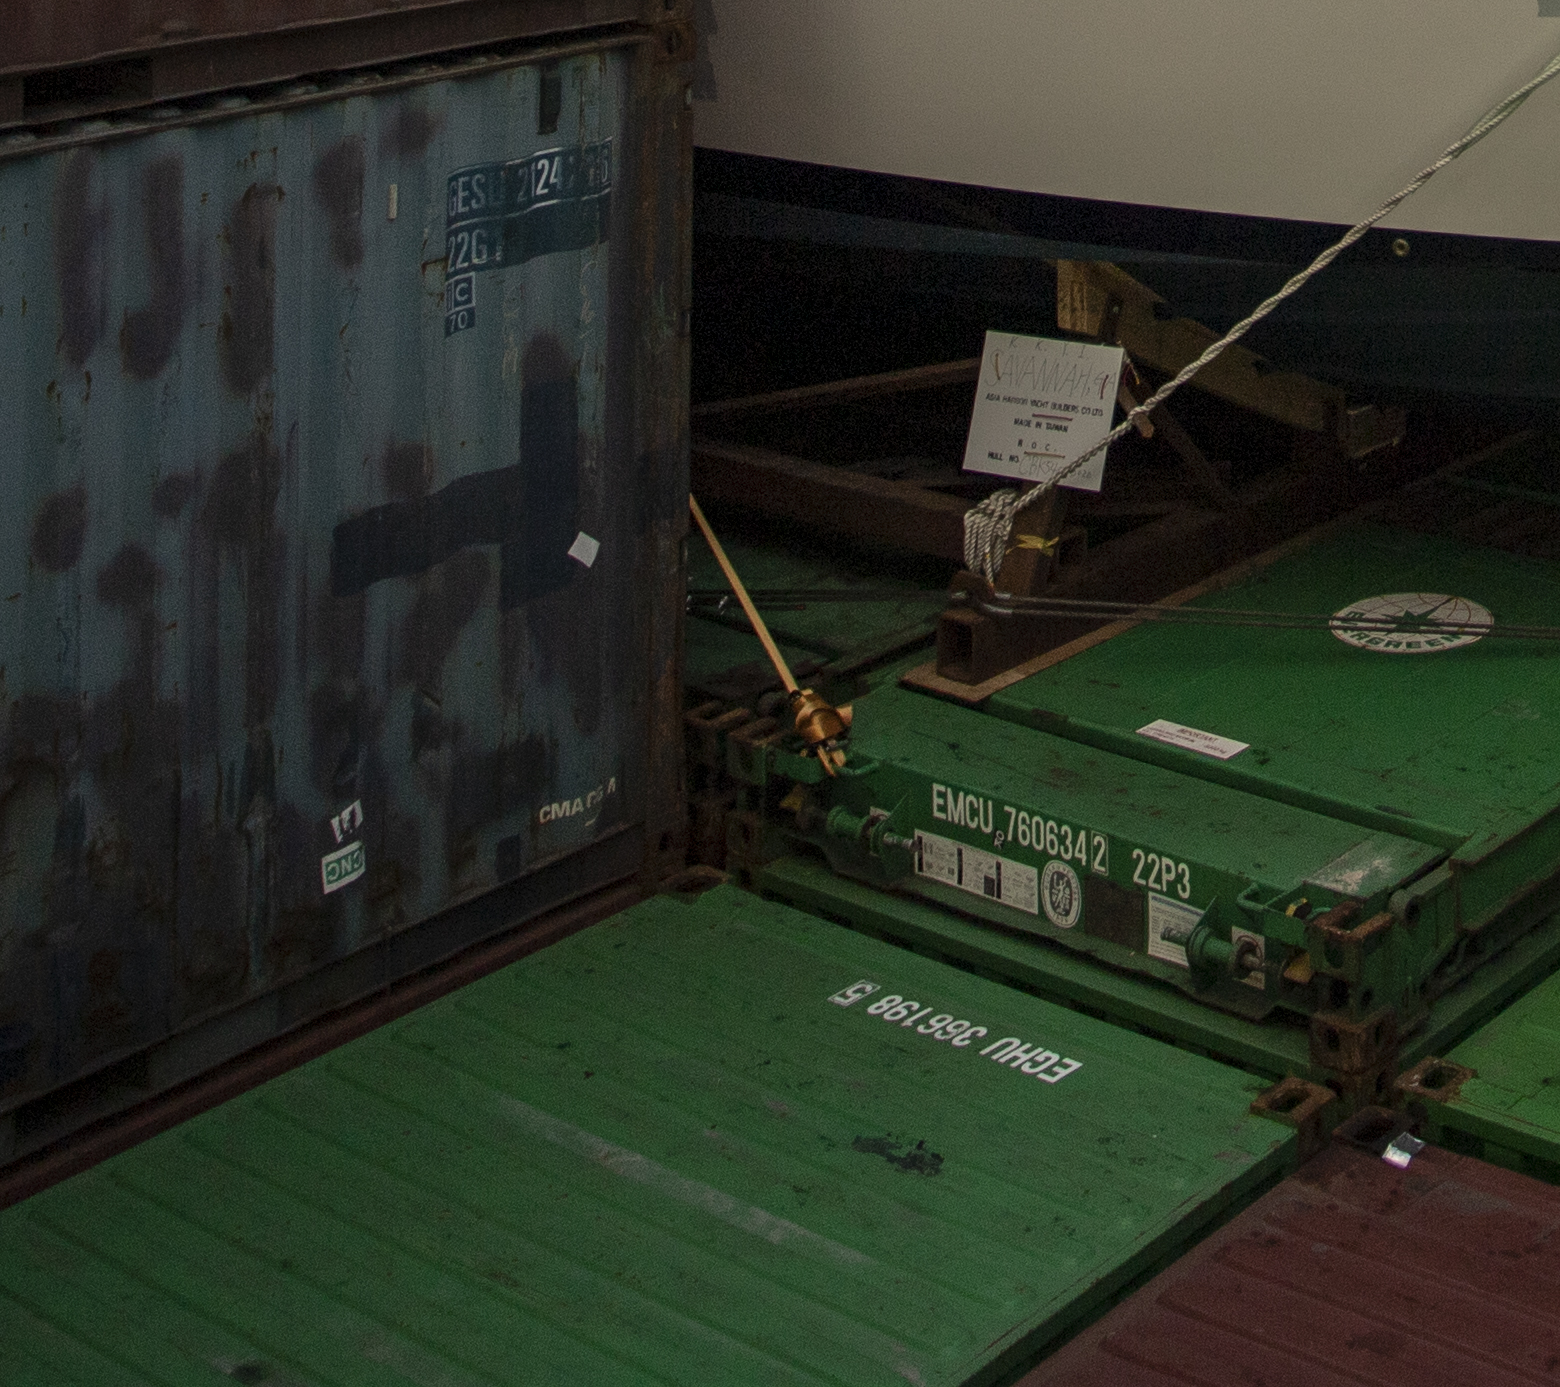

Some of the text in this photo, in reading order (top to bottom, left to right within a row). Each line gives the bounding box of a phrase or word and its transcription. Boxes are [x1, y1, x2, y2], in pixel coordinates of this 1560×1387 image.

[448, 228, 503, 272] 22G
[449, 312, 468, 332] 70
[1013, 417, 1032, 428] MADE
[1035, 421, 1042, 429] IN
[932, 783, 994, 834] EMCU
[1004, 806, 1088, 866] 760634
[1132, 848, 1190, 899] 22P3
[866, 995, 988, 1047] 366198
[979, 1037, 1083, 1084] EGHU
